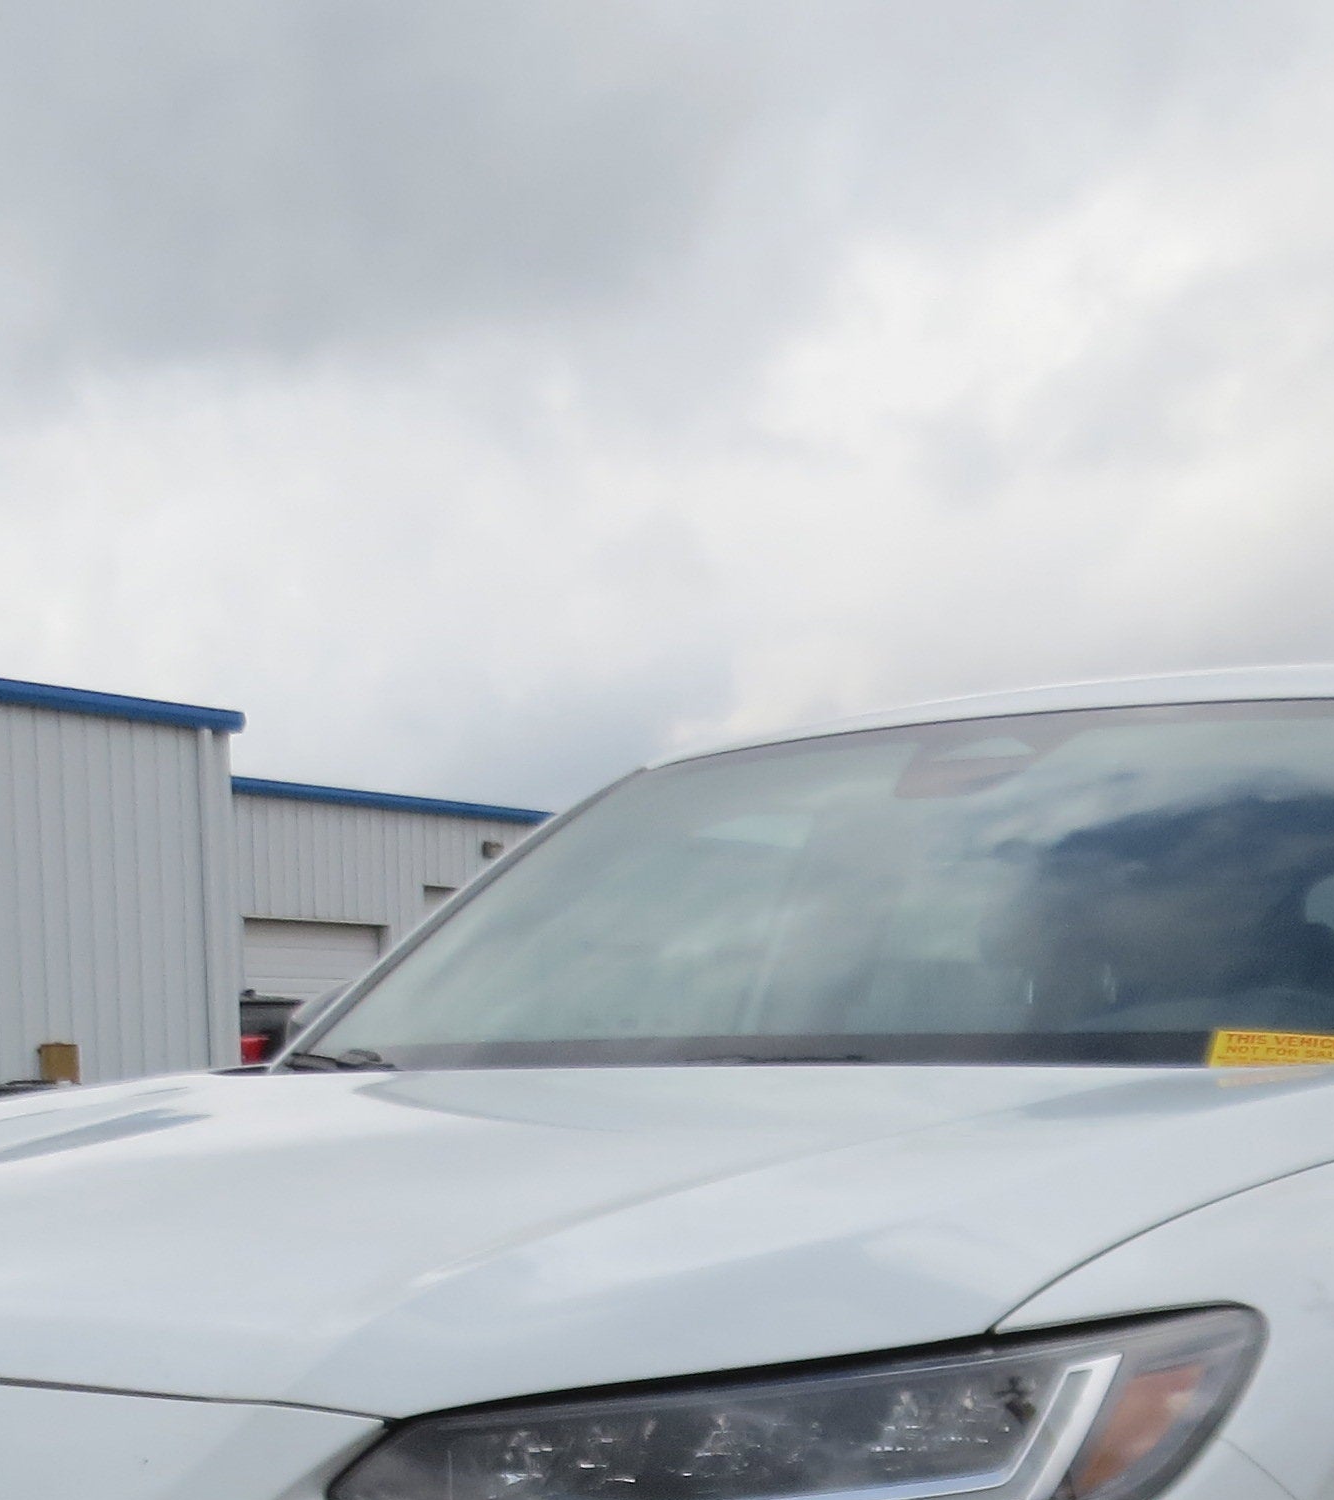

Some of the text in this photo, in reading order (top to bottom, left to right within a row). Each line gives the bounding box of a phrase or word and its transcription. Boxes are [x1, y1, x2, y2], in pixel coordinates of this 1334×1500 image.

[1226, 1033, 1268, 1045] THIS
[1226, 1045, 1260, 1055] NOT
[1266, 1047, 1299, 1057] FOR
